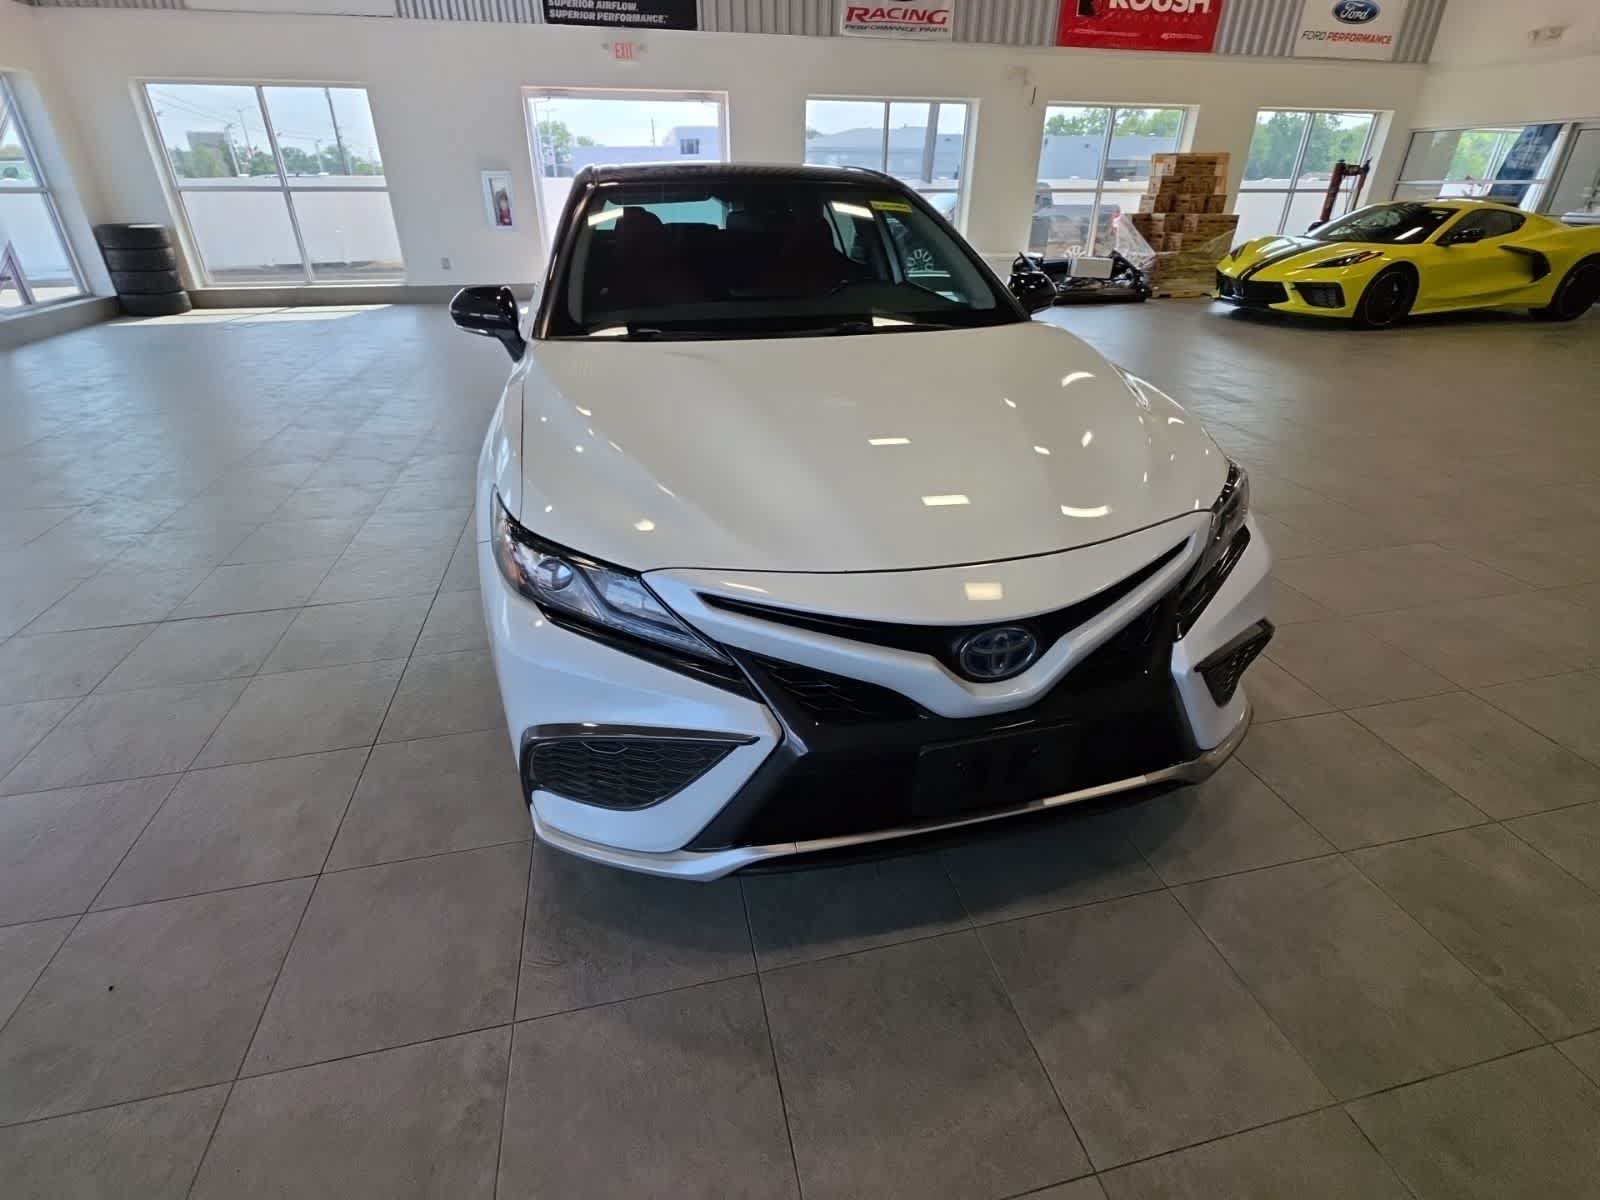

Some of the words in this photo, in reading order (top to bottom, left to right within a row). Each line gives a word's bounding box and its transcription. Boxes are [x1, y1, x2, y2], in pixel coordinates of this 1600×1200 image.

[548, 0, 595, 8] SUPERIOR
[1340, 1, 1370, 19] Ford
[549, 9, 596, 20] SUPERIOR
[846, 7, 950, 25] RACING
[845, 24, 917, 33] PERFORMANCE
[1302, 30, 1327, 40] FORD
[1327, 31, 1393, 45] PERFORMANCE
[615, 42, 634, 60] EXIT
